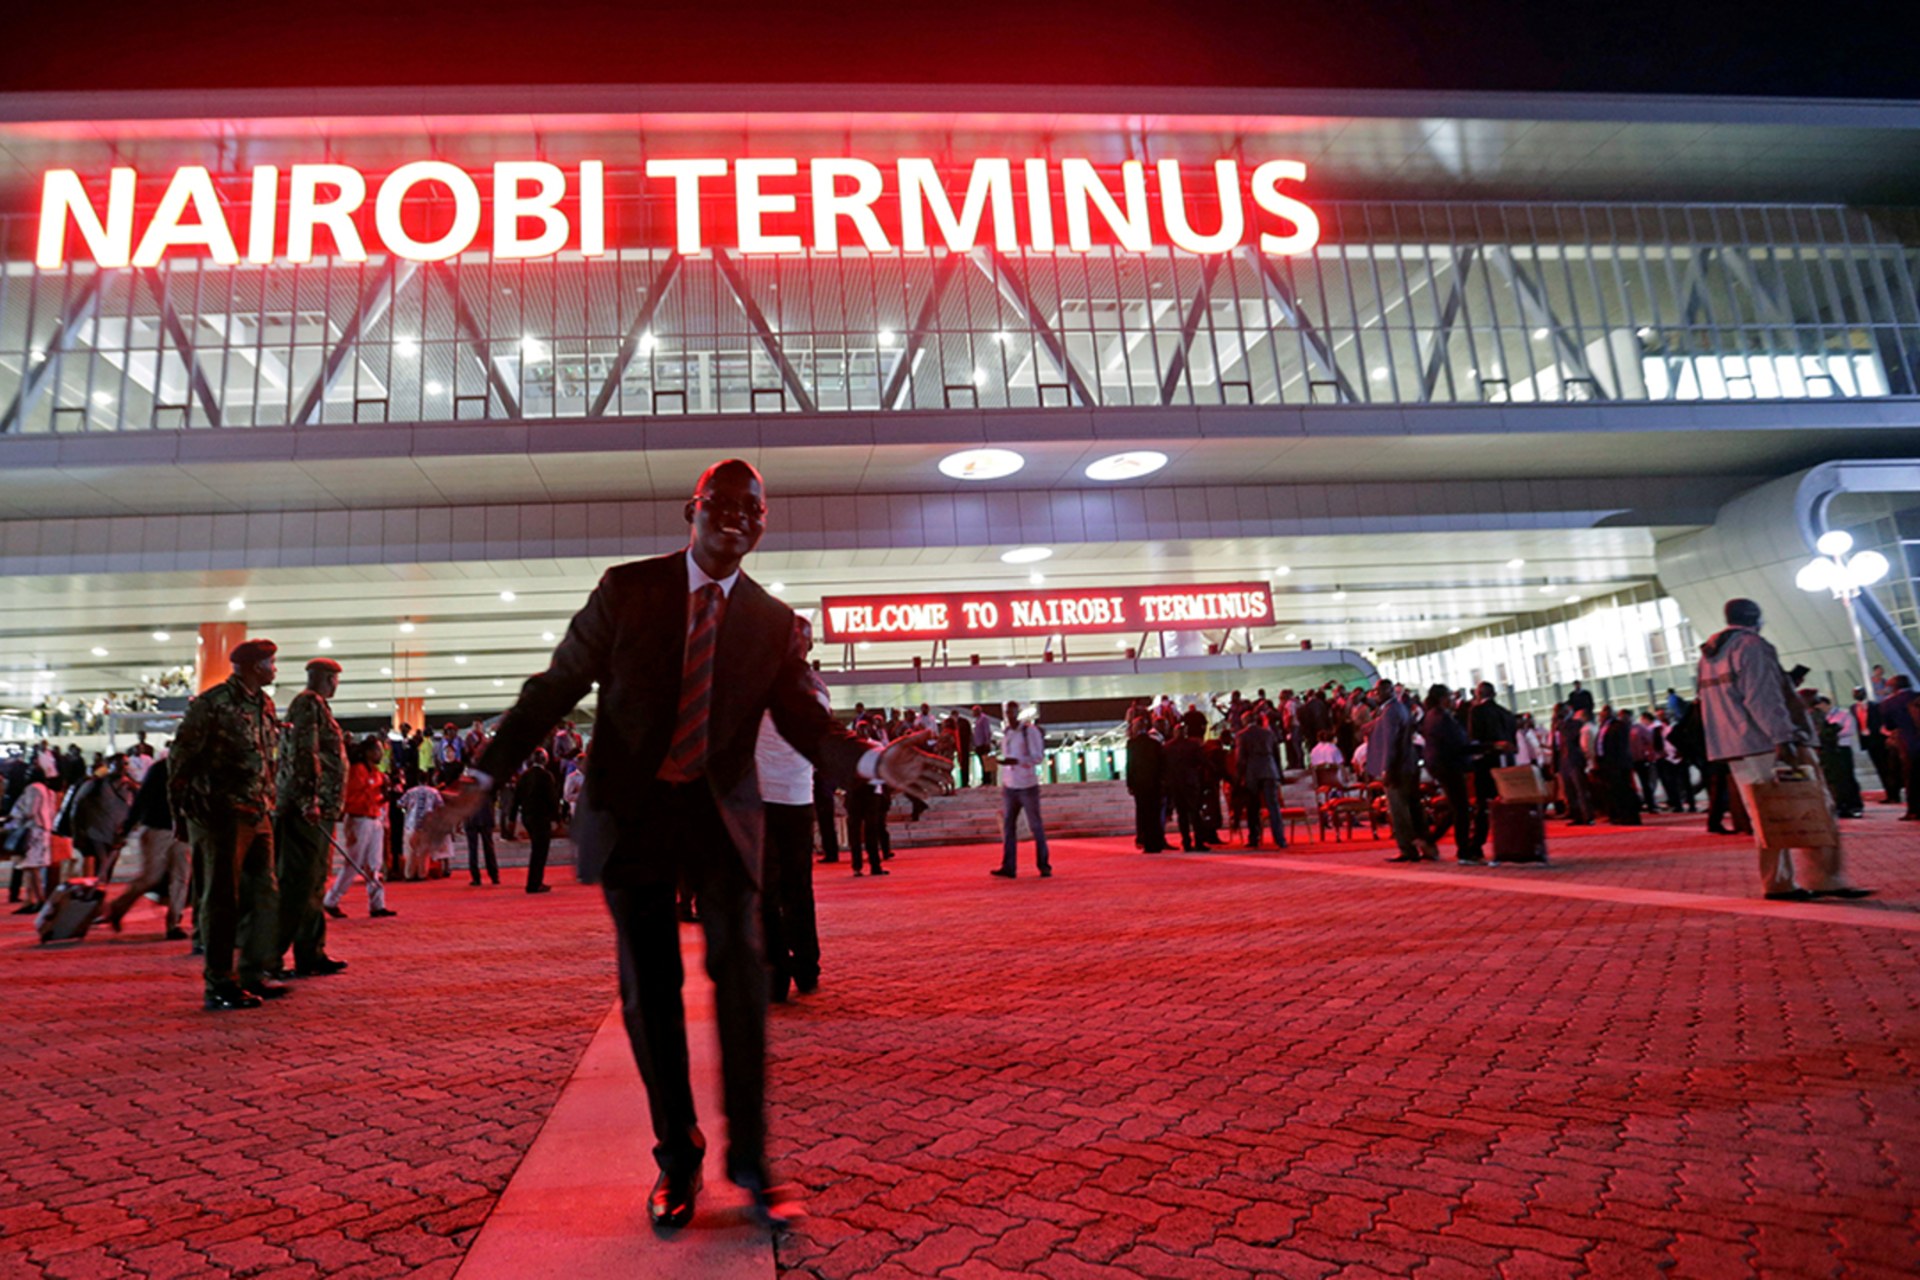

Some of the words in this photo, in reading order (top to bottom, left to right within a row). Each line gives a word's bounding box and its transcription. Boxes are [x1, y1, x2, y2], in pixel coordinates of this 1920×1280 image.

[36, 160, 605, 269] NAIROBI
[645, 157, 1321, 256] TERMINUS
[828, 603, 949, 633] WELCOME
[962, 602, 998, 628] TO
[1010, 597, 1126, 627] NAIROBI
[1139, 591, 1268, 622] TERMINUS
